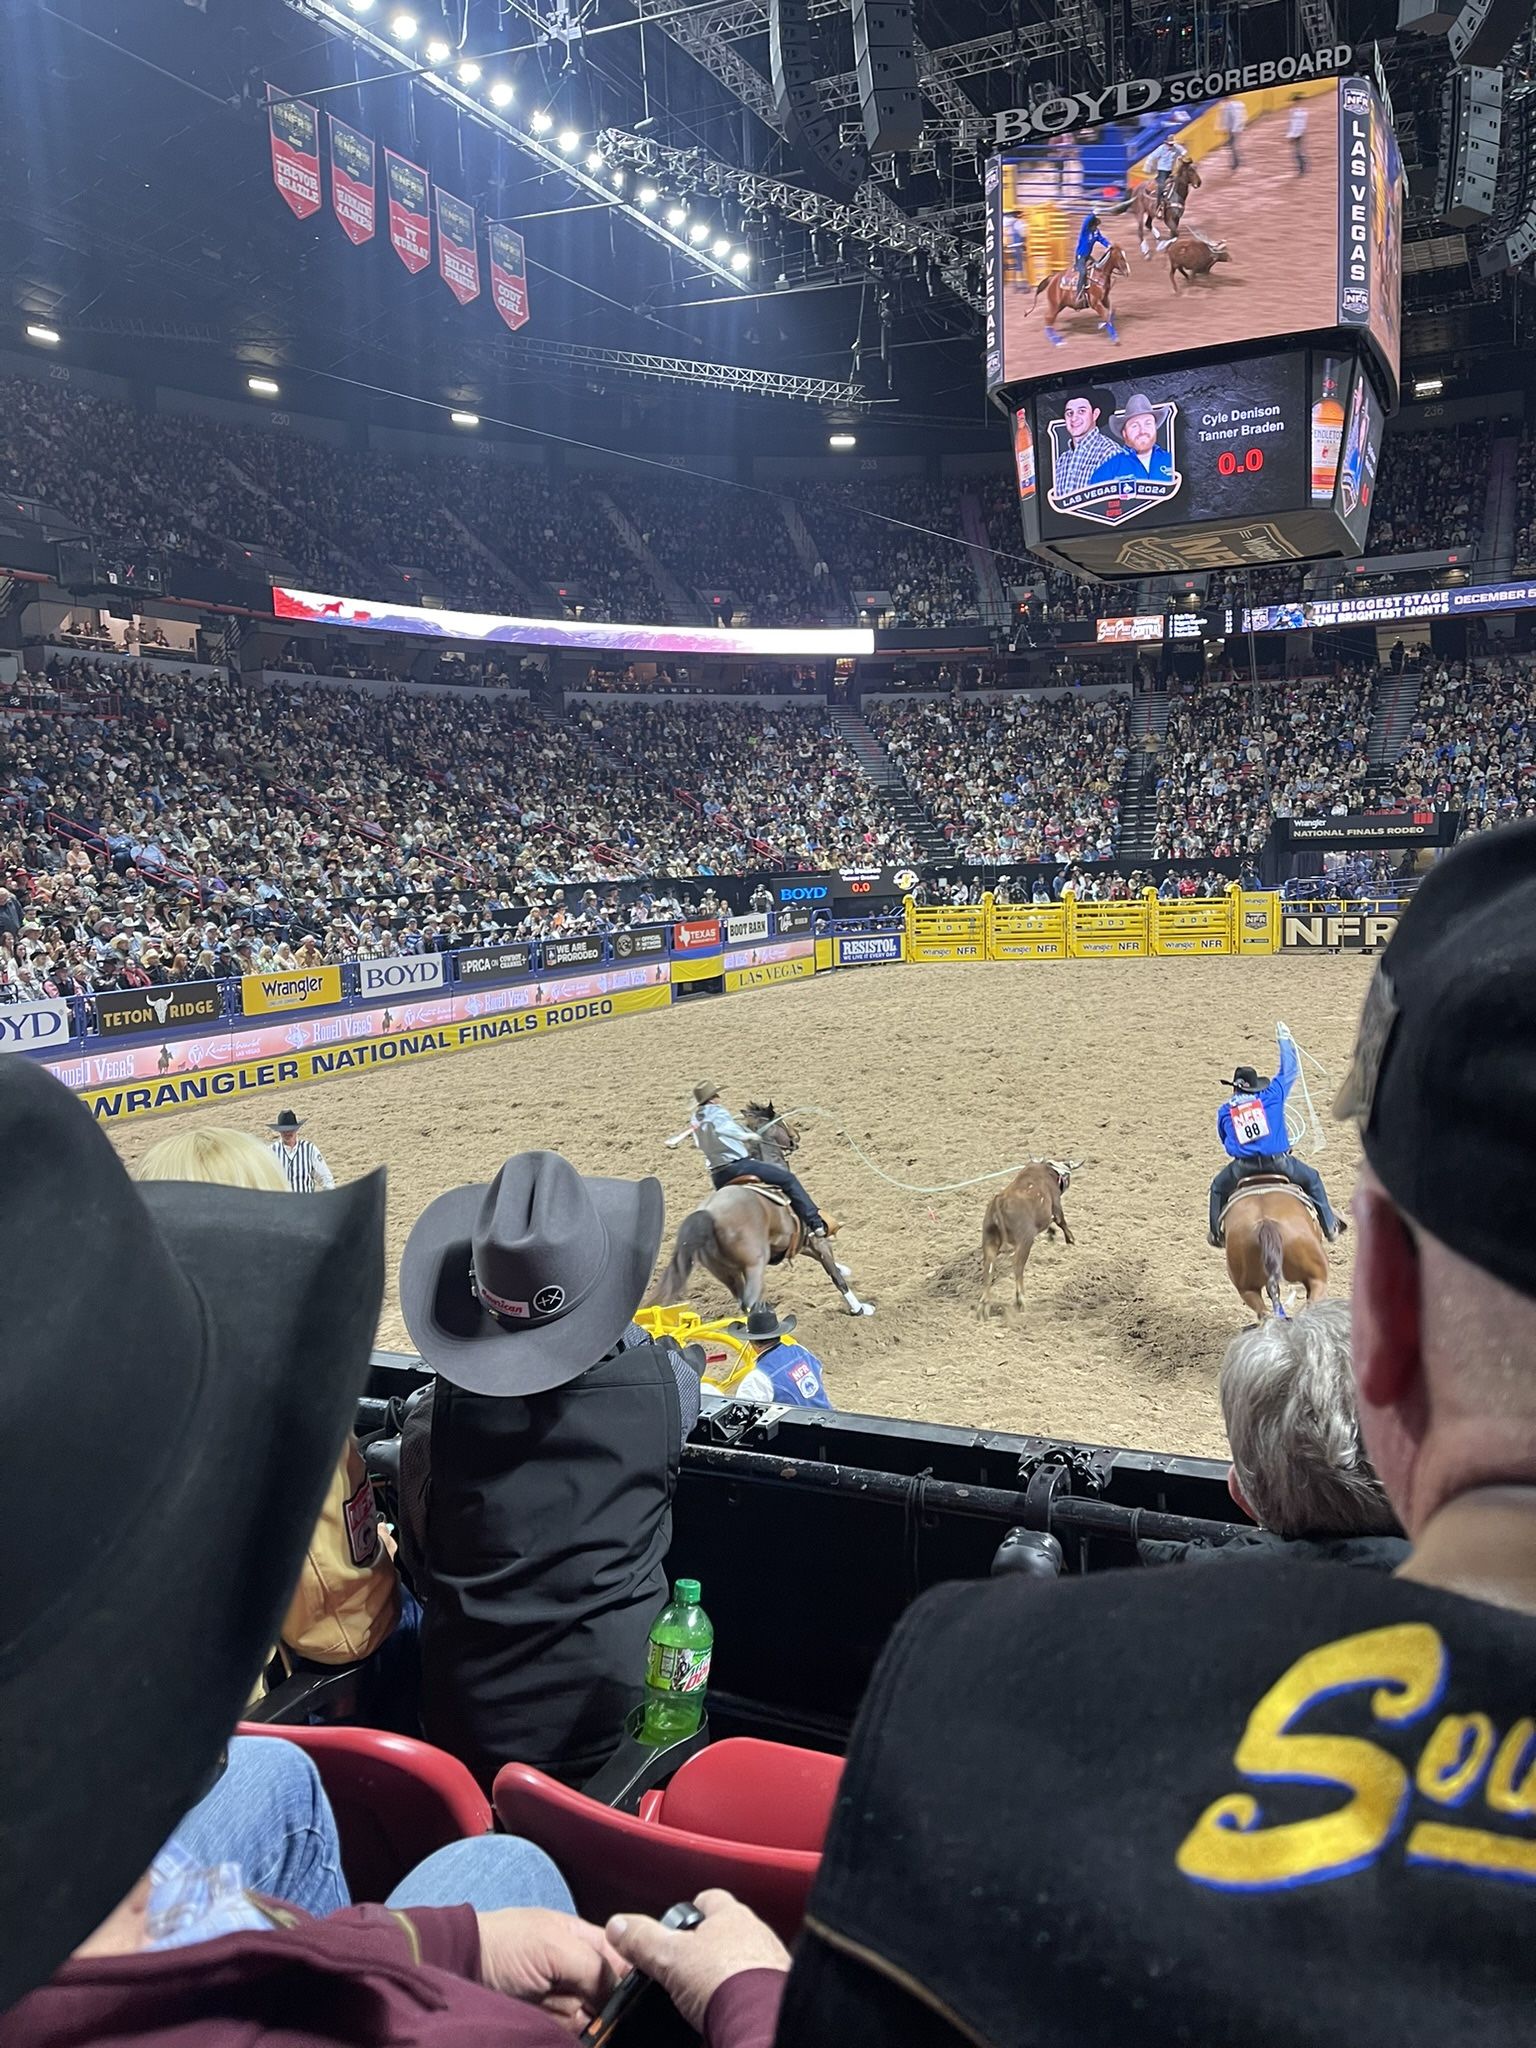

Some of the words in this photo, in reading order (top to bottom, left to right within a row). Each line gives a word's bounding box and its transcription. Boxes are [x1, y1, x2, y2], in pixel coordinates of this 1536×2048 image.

[993, 78, 1162, 145] BOYD
[1170, 44, 1353, 103] SCOREBOARD
[1350, 121, 1366, 176] LAS
[985, 201, 995, 252] LAS
[1350, 185, 1366, 281] VEGAS
[985, 258, 996, 349] VEGAS
[50, 365, 71, 380] 229
[272, 411, 290, 426] 230
[1202, 412, 1229, 428] Cyle
[1231, 405, 1281, 422] Denison
[1199, 427, 1239, 442] Tanner
[1241, 421, 1285, 436] Braden
[1217, 447, 1264, 476] 0.0
[1063, 493, 1082, 507] LAS
[1084, 485, 1117, 500] VEGAS
[1137, 485, 1166, 495] 2024
[1314, 601, 1340, 614] THE
[1341, 596, 1402, 612] BIGGEST
[1404, 592, 1450, 606] STAGE
[1454, 591, 1525, 605] DECEMBER
[1337, 608, 1402, 623] BRIGHTEST
[1405, 602, 1450, 617] LIGHTS
[1293, 819, 1327, 829] Wrangler
[1293, 829, 1344, 838] NATIONAL
[1347, 828, 1385, 837] FINALS
[1387, 826, 1425, 835] RODEO
[780, 887, 827, 900] BOYD
[851, 883, 871, 893] 0.0
[729, 920, 748, 937] BOOT
[749, 918, 766, 935] BARN
[1246, 915, 1267, 924] NFR
[690, 928, 716, 940] TEXAS
[1285, 917, 1400, 946] NFR
[556, 944, 571, 954] WE
[571, 942, 587, 952] ARE
[843, 938, 897, 953] RESISTOL
[956, 947, 977, 955] NFR
[1036, 945, 1057, 953] NFR
[1118, 942, 1139, 951] NFR
[1201, 939, 1222, 948] NFR
[557, 949, 598, 963] PRORODEO
[870, 951, 885, 959] EVERY
[886, 950, 897, 958] DAY
[467, 958, 491, 973] PRCA
[491, 959, 499, 967] ON
[739, 970, 762, 986] LAS
[767, 962, 804, 980] VEGAS
[367, 962, 439, 989] BOYD
[261, 976, 323, 1001] Wrangler
[104, 1007, 153, 1028] TETON
[170, 1000, 214, 1019] RIDGE
[344, 1015, 372, 1038] VEGAS
[84, 1060, 299, 1119] WRANGLER
[311, 1031, 451, 1075] NATIONAL
[459, 1014, 538, 1045] FINALS
[546, 999, 613, 1027] RODEO
[93, 1053, 134, 1082] VEGAS
[1244, 1122, 1260, 1139] 88
[791, 1362, 810, 1382] NFR
